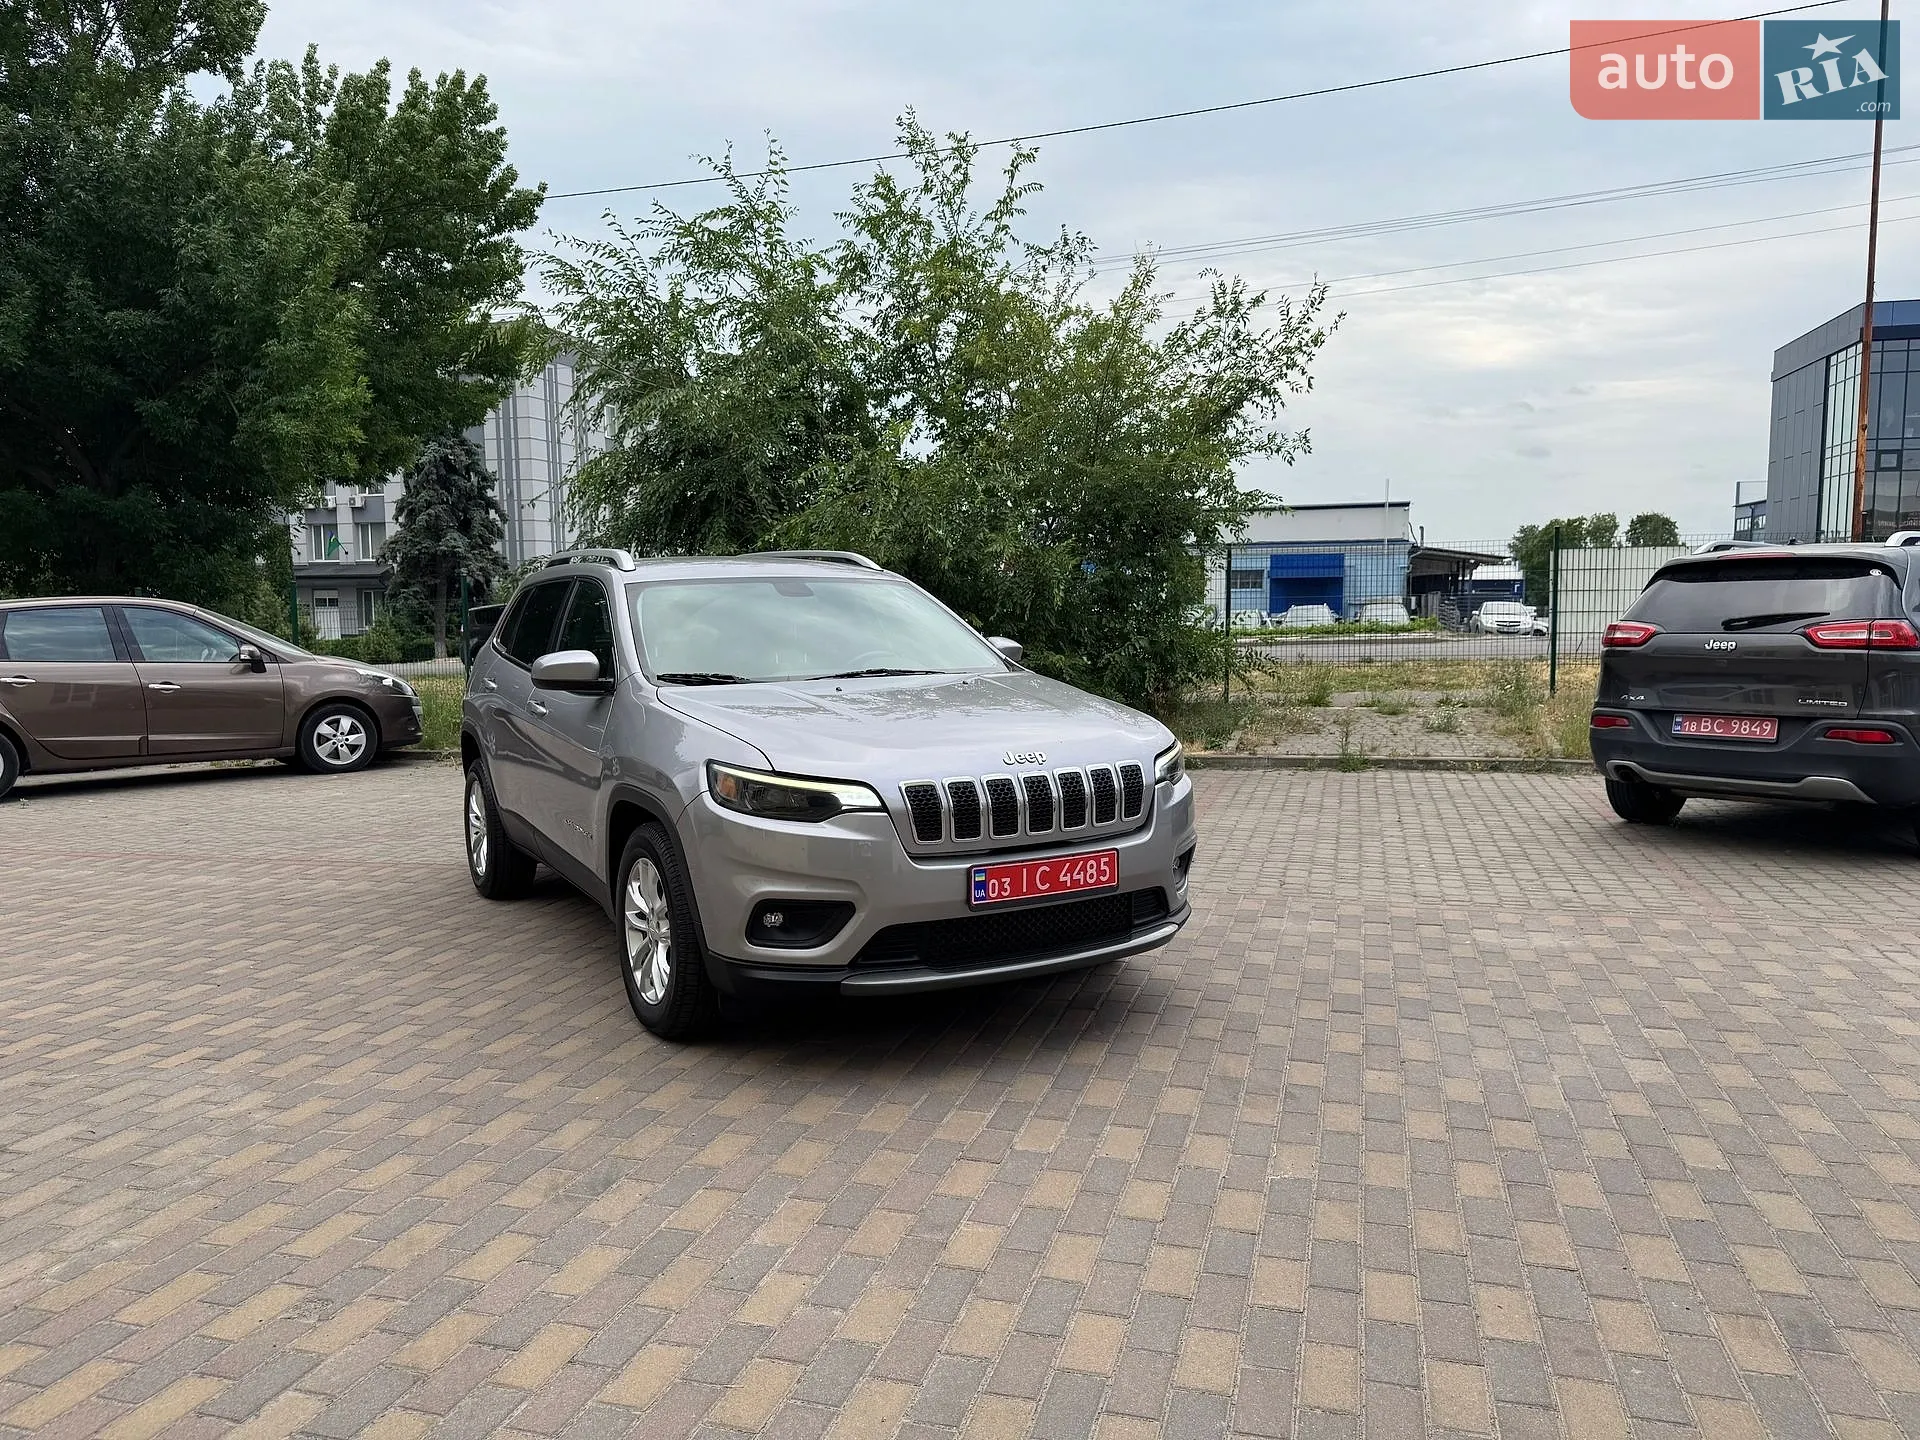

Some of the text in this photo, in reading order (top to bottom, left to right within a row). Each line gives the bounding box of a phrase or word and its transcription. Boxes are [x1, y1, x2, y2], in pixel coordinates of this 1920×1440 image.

[1704, 639, 1737, 651] Jeep
[1683, 718, 1772, 736] 18 BC 9849
[1002, 750, 1047, 766] Jeep
[988, 877, 1011, 898] 03
[1059, 857, 1110, 887] 4485
[975, 889, 986, 898] UA
